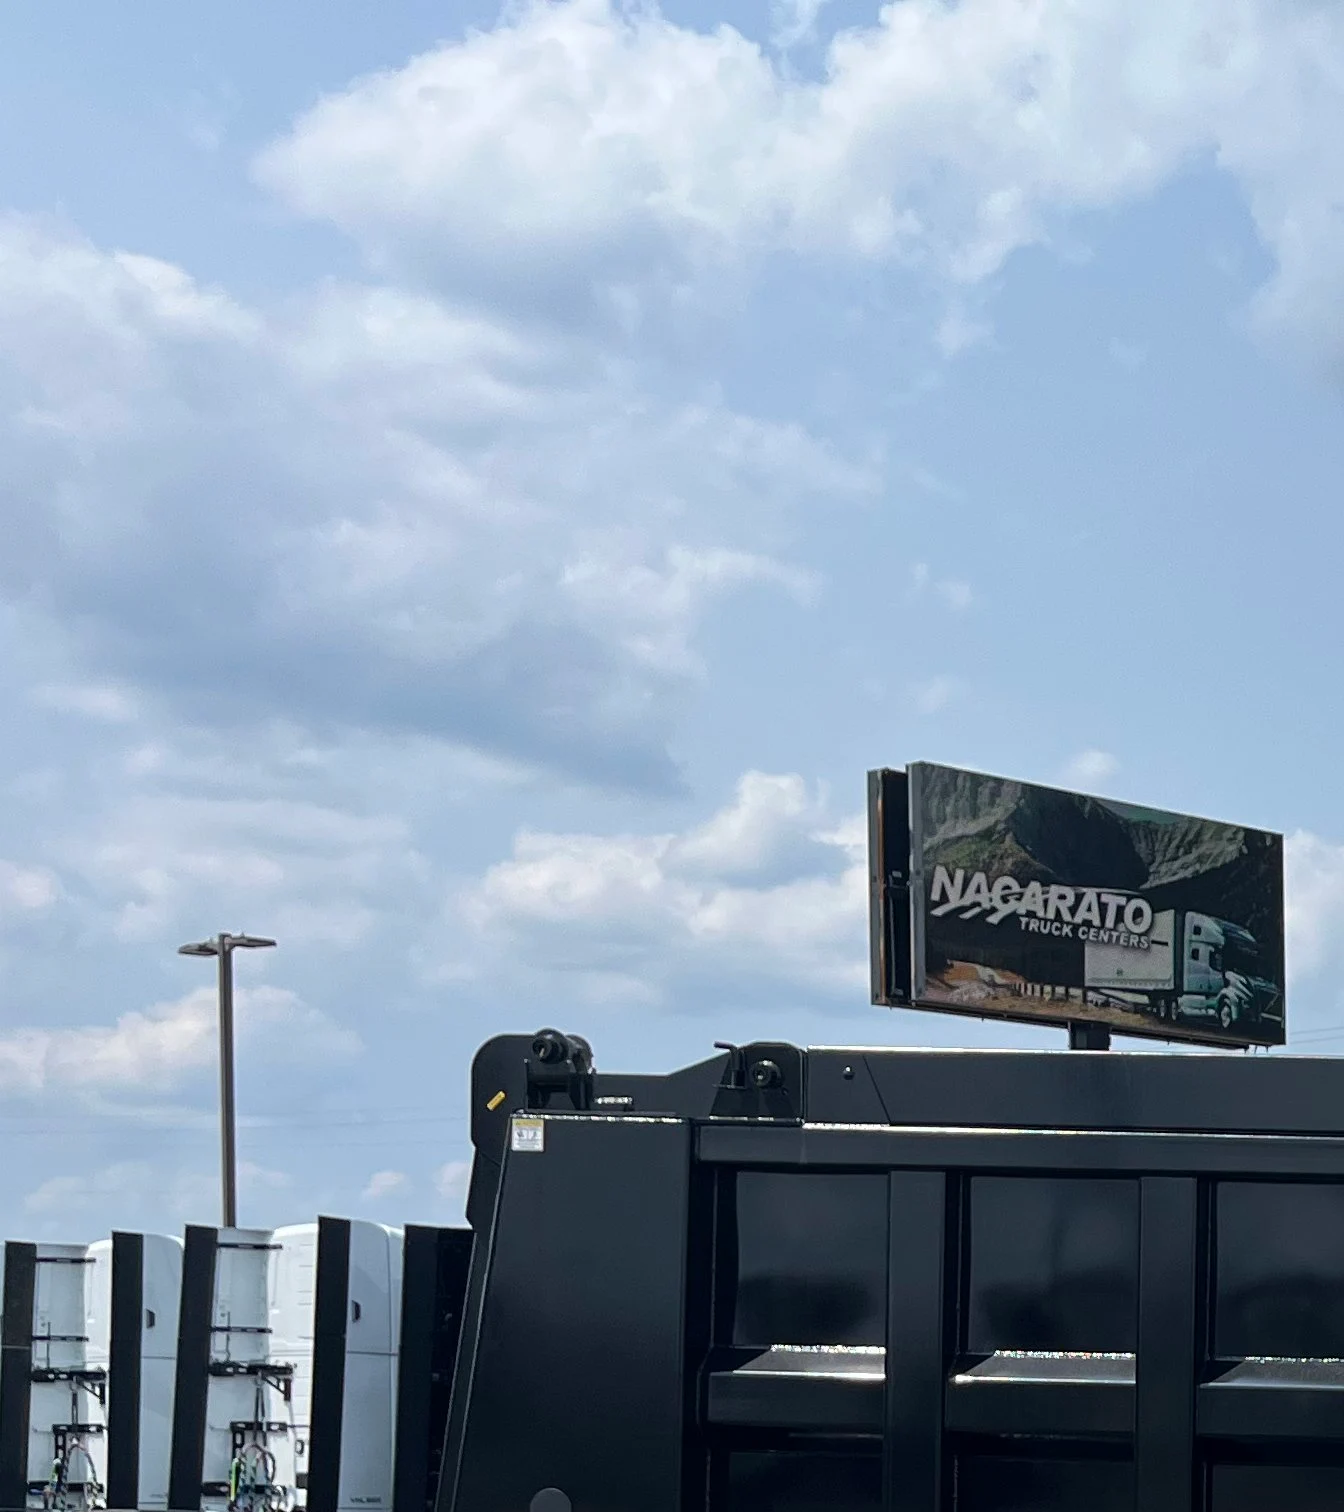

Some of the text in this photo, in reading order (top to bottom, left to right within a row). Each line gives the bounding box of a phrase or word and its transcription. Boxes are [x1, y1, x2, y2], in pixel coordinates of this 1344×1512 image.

[931, 865, 1153, 932] NAGARATO
[1020, 916, 1151, 950] TRUCK CENTERS
